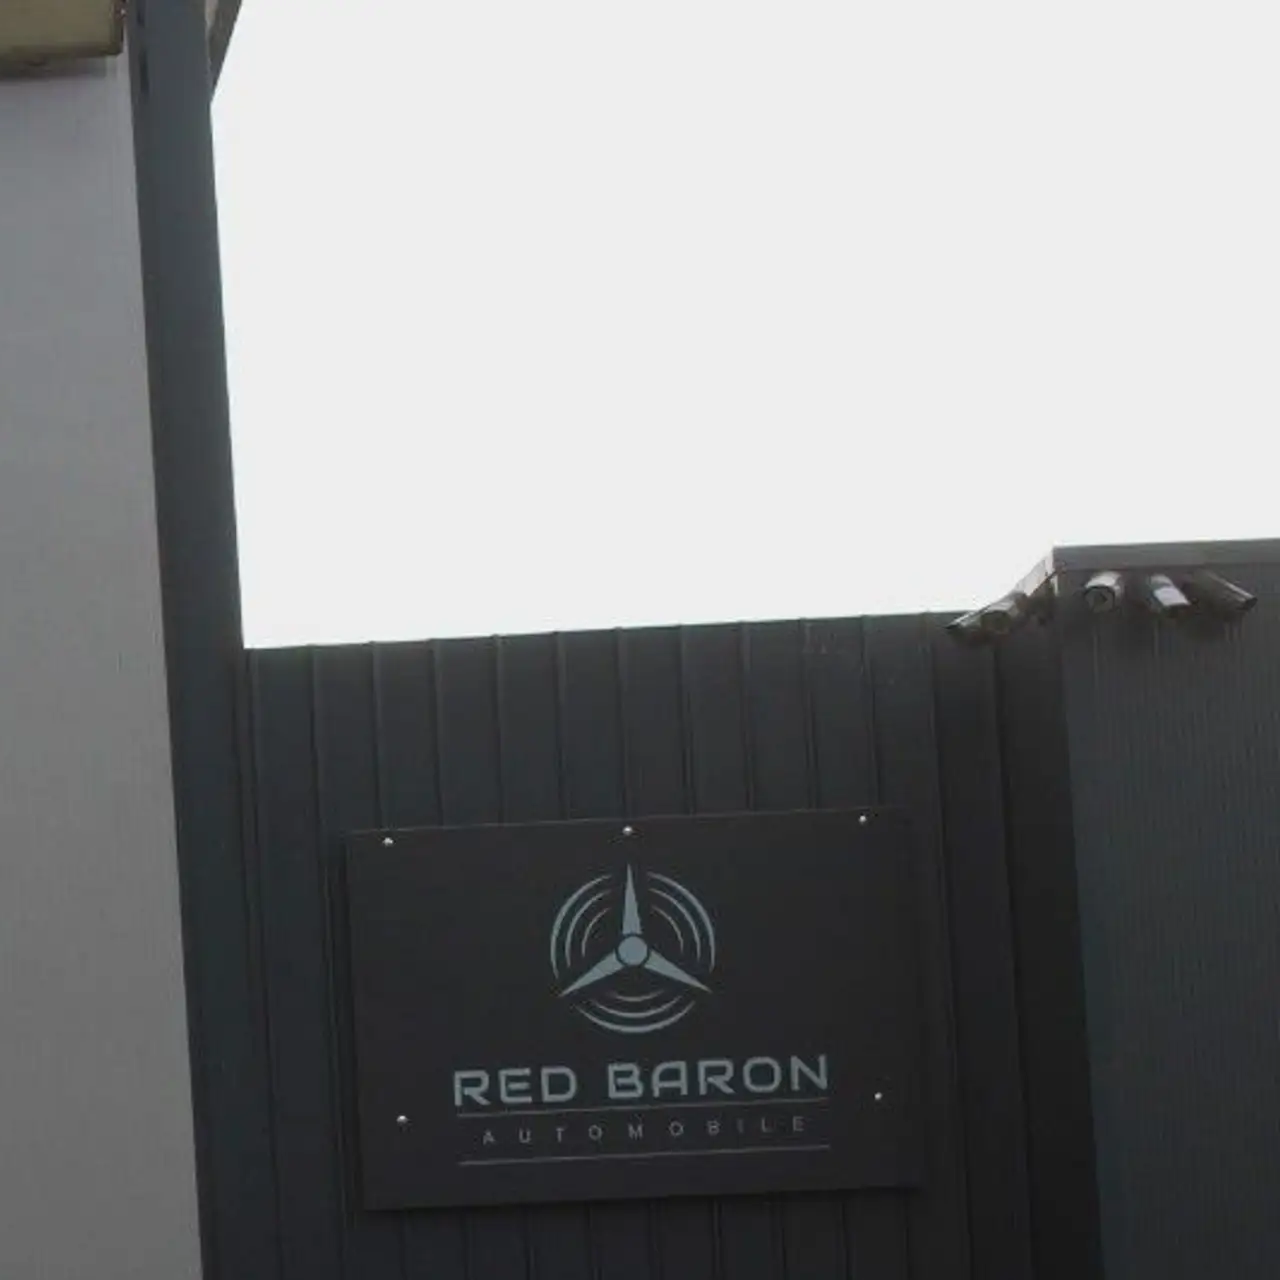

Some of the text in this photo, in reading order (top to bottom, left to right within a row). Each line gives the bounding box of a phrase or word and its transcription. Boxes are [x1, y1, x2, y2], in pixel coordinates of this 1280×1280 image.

[453, 1053, 829, 1107] RED BARON
[482, 1115, 806, 1146] AUTOMOBILE
